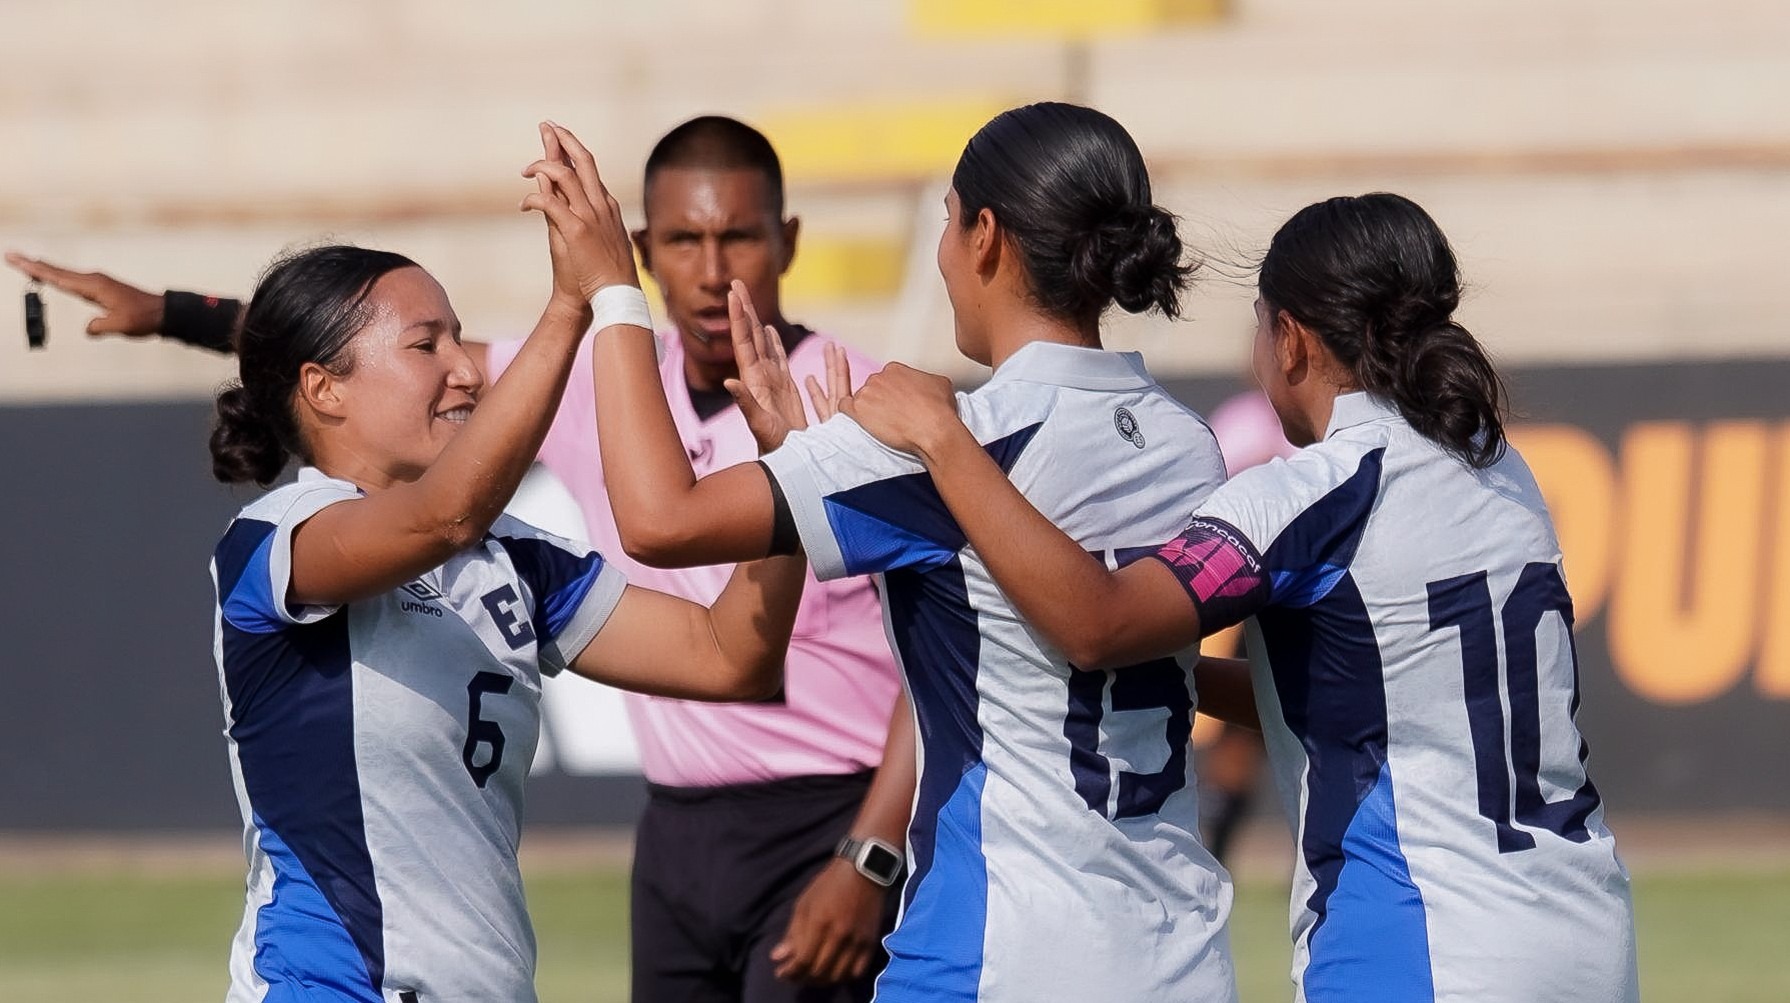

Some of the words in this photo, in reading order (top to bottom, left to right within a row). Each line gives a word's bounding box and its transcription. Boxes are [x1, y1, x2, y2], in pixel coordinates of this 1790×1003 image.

[401, 601, 442, 617] umbro
[480, 583, 536, 651] E
[1504, 421, 1790, 704] PU
[462, 670, 514, 789] 6
[1426, 561, 1602, 854] 10
